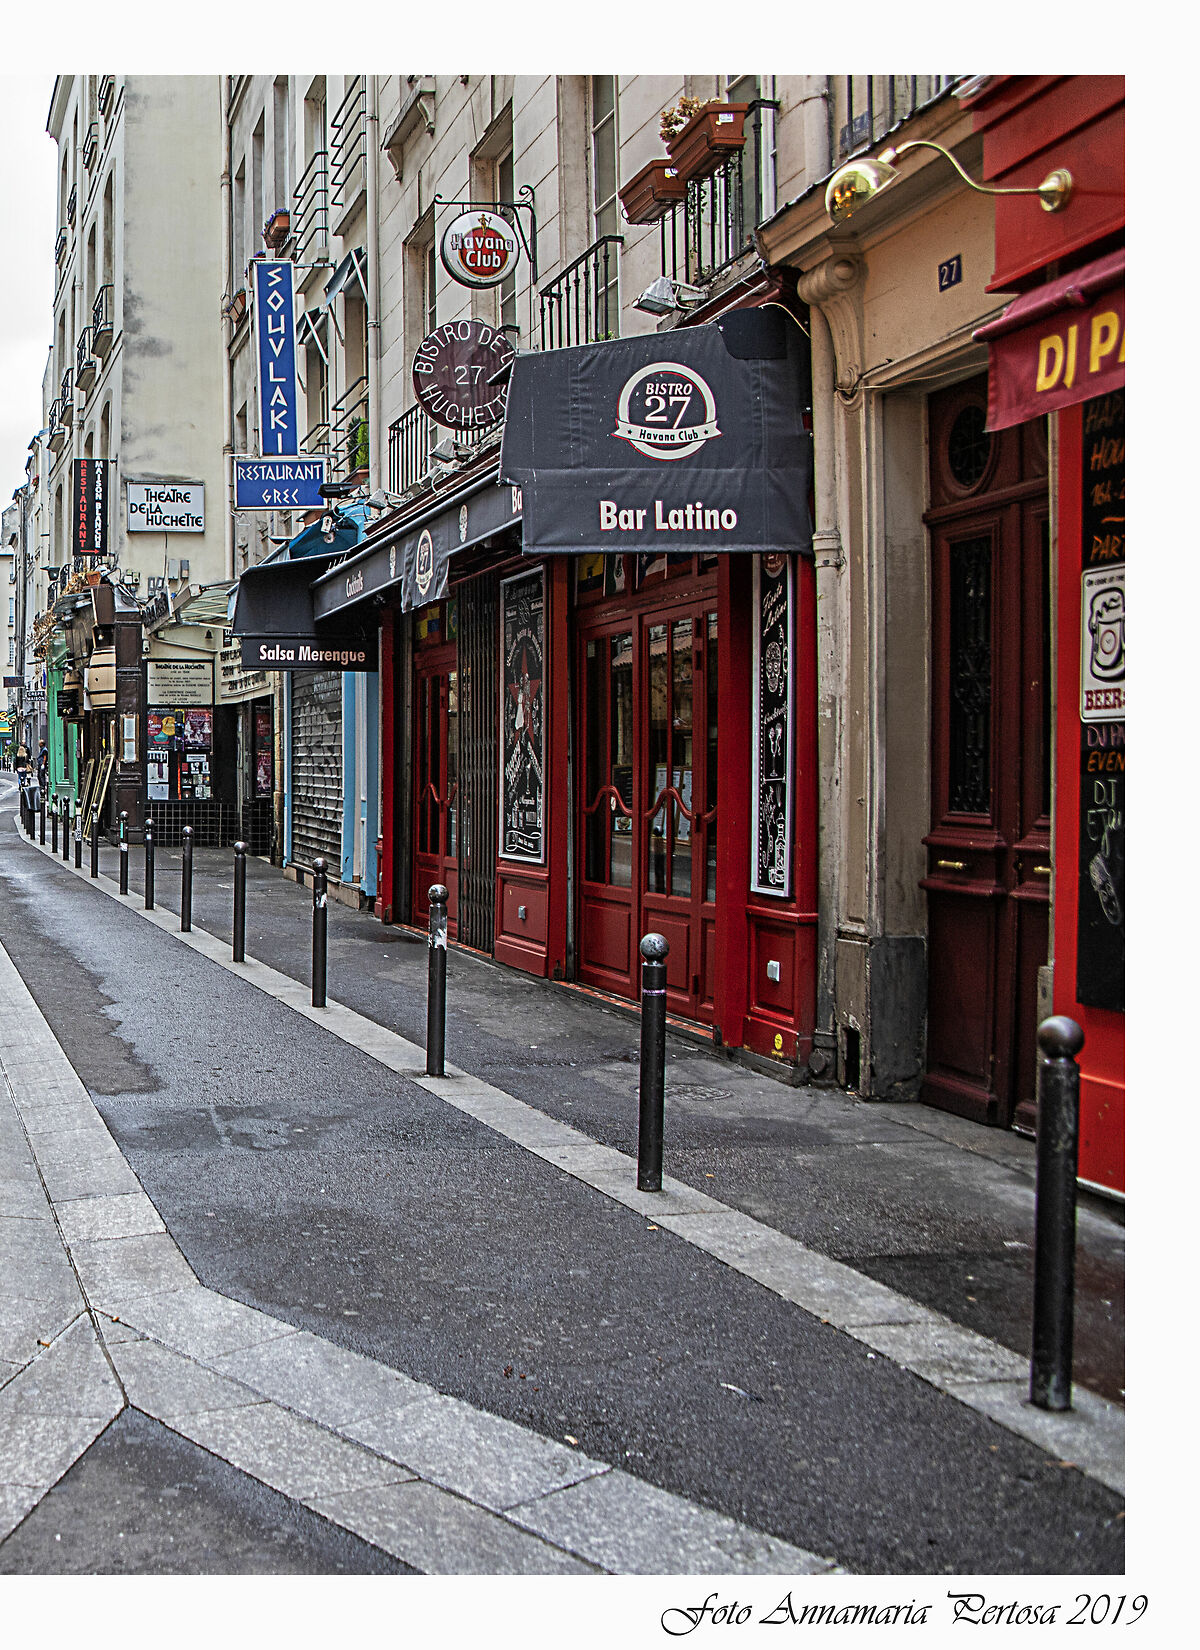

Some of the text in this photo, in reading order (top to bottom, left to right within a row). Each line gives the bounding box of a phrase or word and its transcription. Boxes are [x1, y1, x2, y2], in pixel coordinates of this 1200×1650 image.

[451, 233, 514, 252] Havana
[466, 251, 501, 268] Club
[940, 260, 958, 286] 27
[414, 321, 471, 374] BISTRO
[478, 327, 506, 352] DE
[1089, 311, 1125, 373] P
[266, 267, 288, 454] SOUVLAKI
[454, 365, 483, 385] 27
[645, 383, 693, 396] BISTRO
[645, 396, 691, 430] 27
[639, 429, 699, 442] Havana Club
[95, 461, 103, 500] MAISON
[238, 464, 323, 481] RESTAURANT
[145, 488, 191, 503] THEATRE
[262, 489, 299, 505] GREC
[511, 486, 523, 514] Ba
[130, 503, 163, 514] DE LA
[146, 509, 203, 527] HUCHETTE
[600, 501, 738, 530] Bar Latino
[259, 644, 294, 661] Salsa
[298, 645, 366, 665] Merengue
[1084, 688, 1125, 711] BEER
